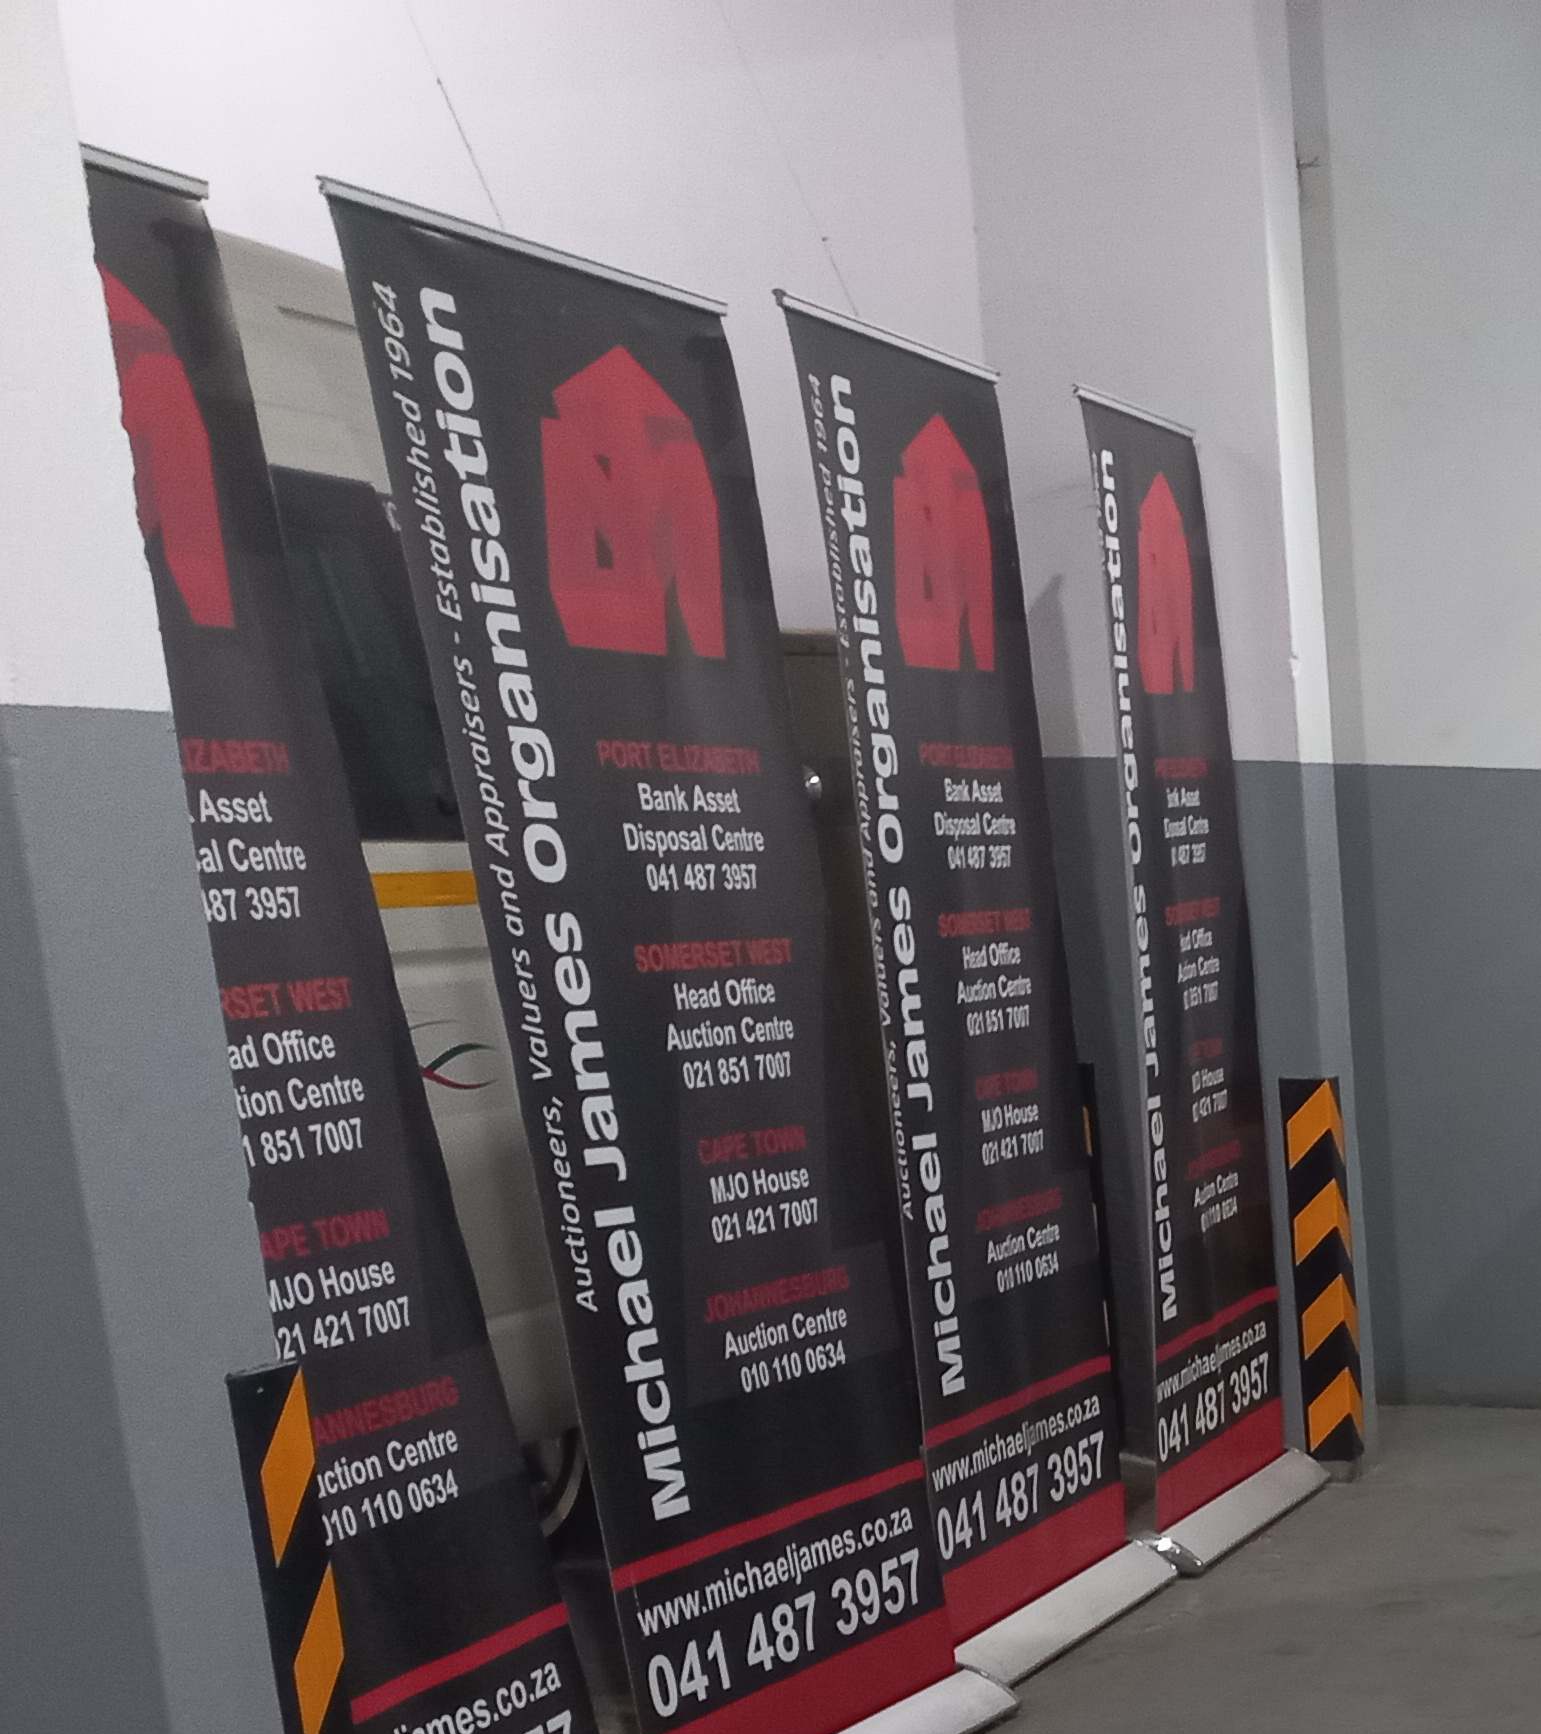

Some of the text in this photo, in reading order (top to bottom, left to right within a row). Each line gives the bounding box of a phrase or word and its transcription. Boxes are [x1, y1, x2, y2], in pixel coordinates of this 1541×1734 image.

[371, 279, 414, 382] 1964
[391, 390, 463, 623] Established
[452, 654, 511, 857] Appraisers
[199, 788, 273, 823] Asset
[637, 782, 742, 814] Bank Asset
[227, 838, 307, 872] Centre
[622, 822, 765, 858] Disposal Centre
[201, 885, 301, 922] 87 3957
[489, 863, 526, 938] and
[646, 863, 757, 893] 041 487 3957
[829, 373, 967, 1398] Michael James Organisation
[1100, 448, 1179, 1322] Michael James Organisation
[420, 286, 692, 1522] Michael James Organisation
[512, 948, 553, 1081] Valuers
[673, 977, 776, 1011] Head Office
[957, 978, 997, 1005] Auction
[226, 1029, 337, 1069] ad Office
[666, 1016, 794, 1052] Auction Centre
[682, 1051, 791, 1090] 021 851 7007
[233, 1074, 365, 1119] tion Centre
[1003, 1103, 1040, 1127] House
[260, 1126, 305, 1165] 851
[308, 1117, 363, 1156] 7007
[543, 1095, 600, 1313] Auctioneers,
[709, 1167, 810, 1205] MJO House
[711, 1197, 818, 1244] 021 421 7007
[986, 1233, 1026, 1265] Auction
[318, 1261, 396, 1300] House
[274, 1295, 411, 1361] 21 421 7007
[724, 1306, 848, 1360] Auction Centre
[740, 1339, 846, 1393] 010 110 0634
[313, 1375, 459, 1446] ANNESBURG
[1158, 1351, 1270, 1464] 041 487 3957
[386, 1429, 459, 1472] Centre
[931, 1394, 1101, 1493] www.michaeljames.co.za
[361, 1489, 404, 1529] 110
[407, 1467, 460, 1513] 0634
[937, 1430, 1105, 1561] 041 487 3957
[636, 1506, 914, 1638] www.michaeljames.co.za
[647, 1548, 921, 1719] 041 487 3957
